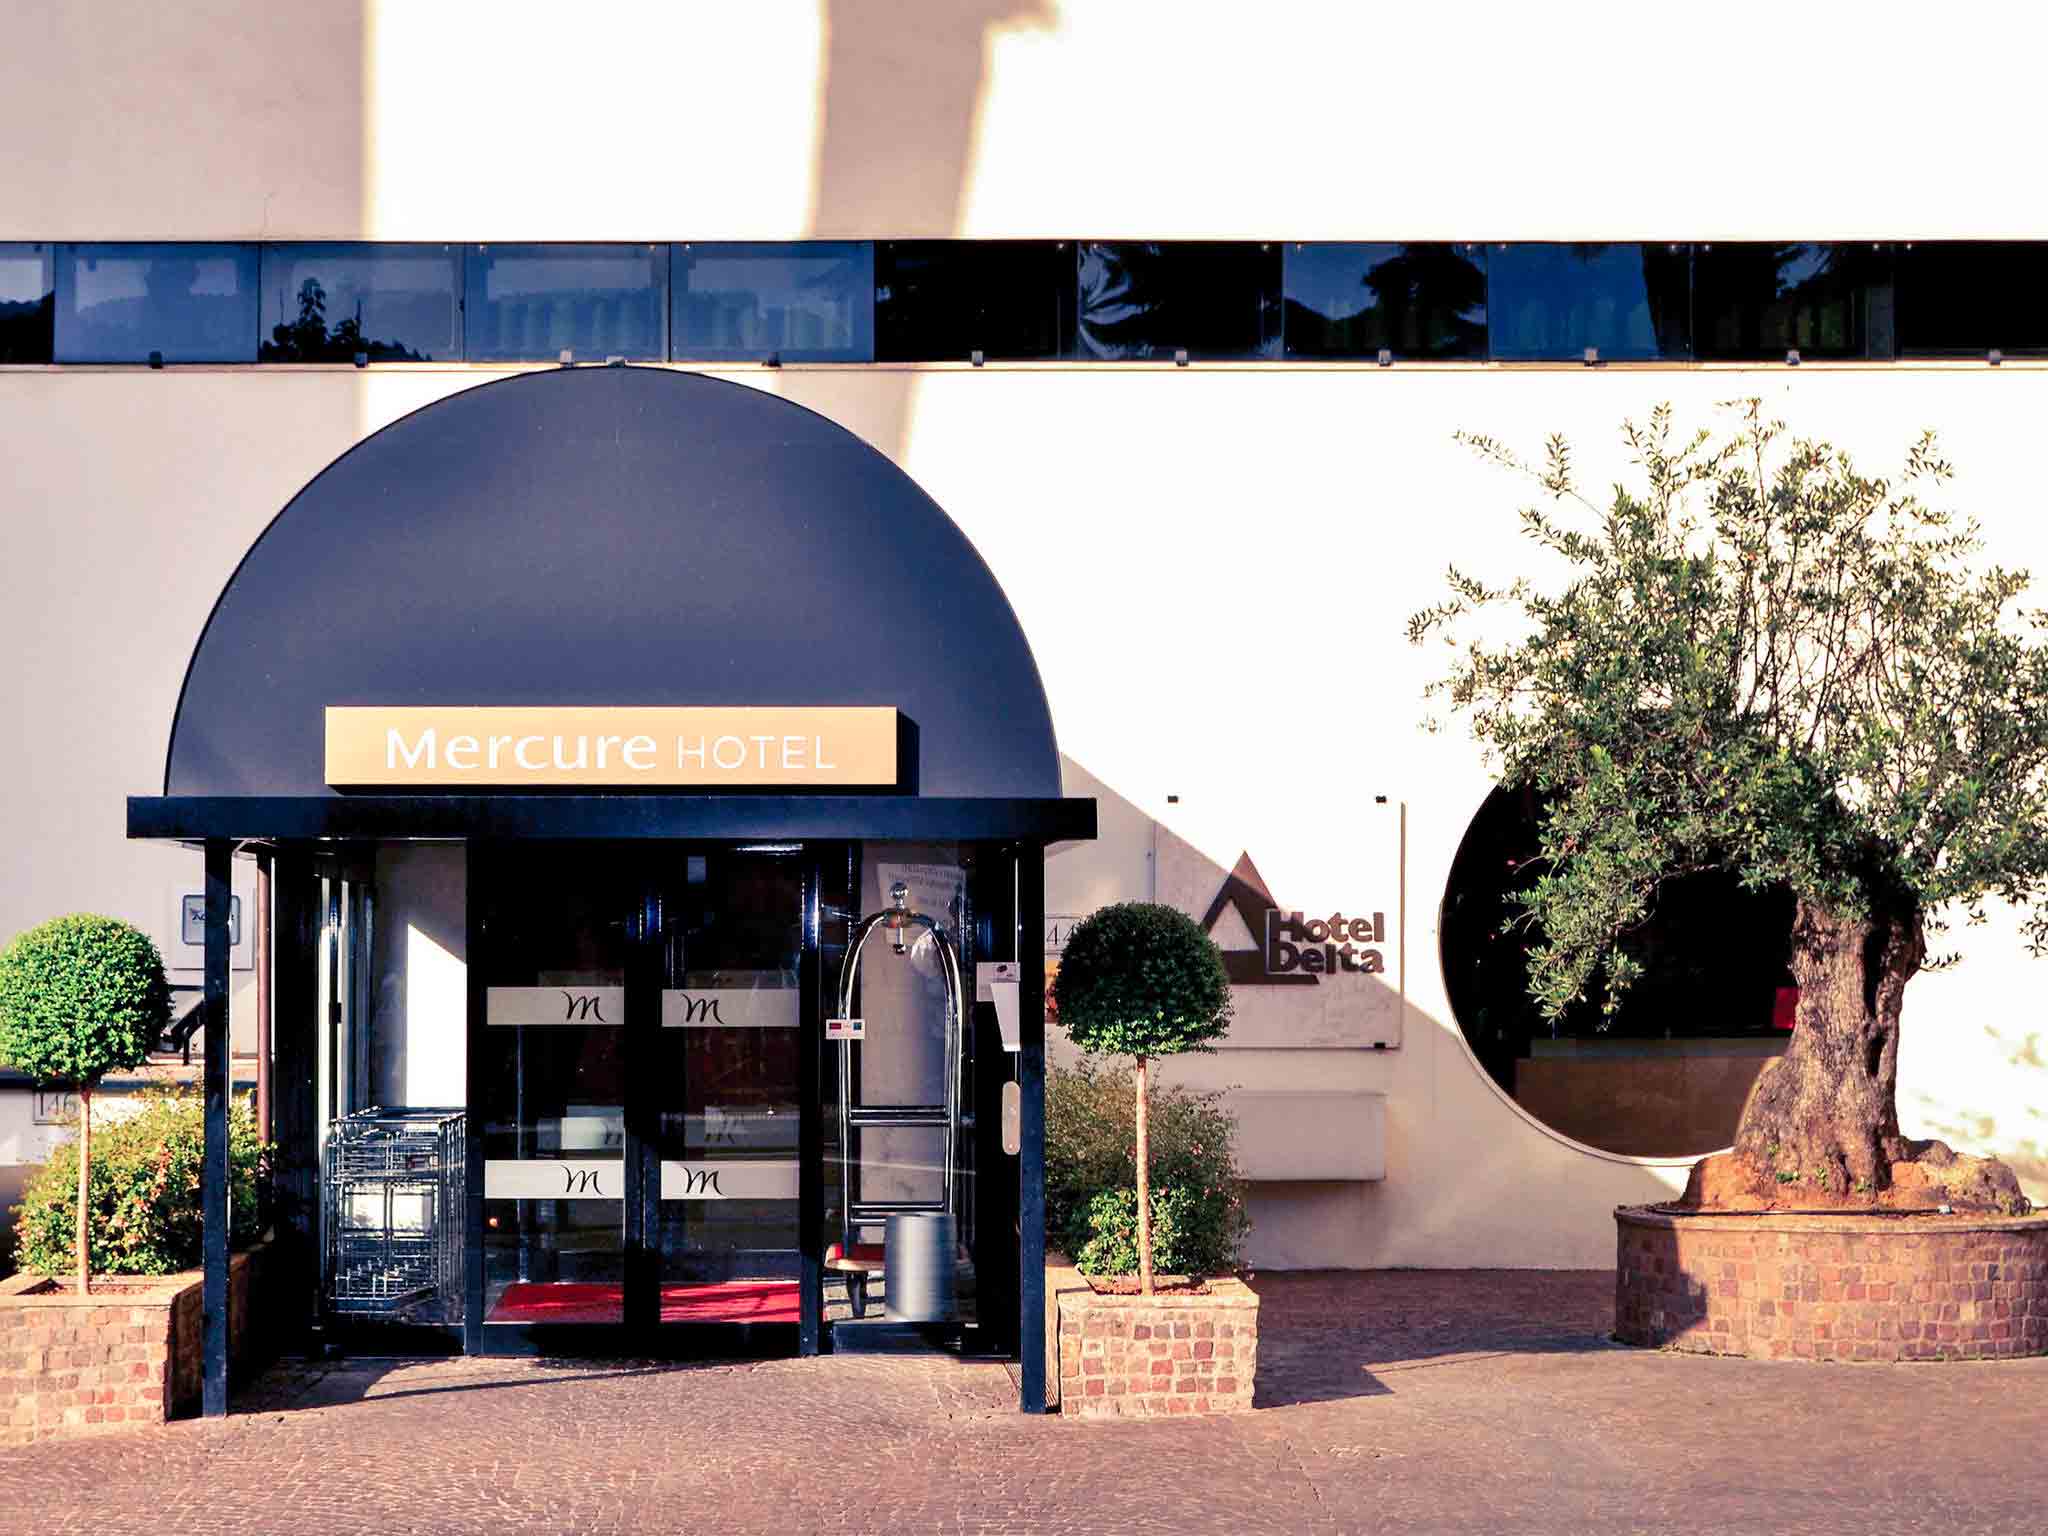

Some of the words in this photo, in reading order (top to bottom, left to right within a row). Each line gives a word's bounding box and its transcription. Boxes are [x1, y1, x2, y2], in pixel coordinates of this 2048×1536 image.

[385, 727, 658, 770] Mercure
[677, 735, 837, 769] HOTEL
[1269, 911, 1385, 943] Hotel
[1269, 941, 1385, 975] Delta
